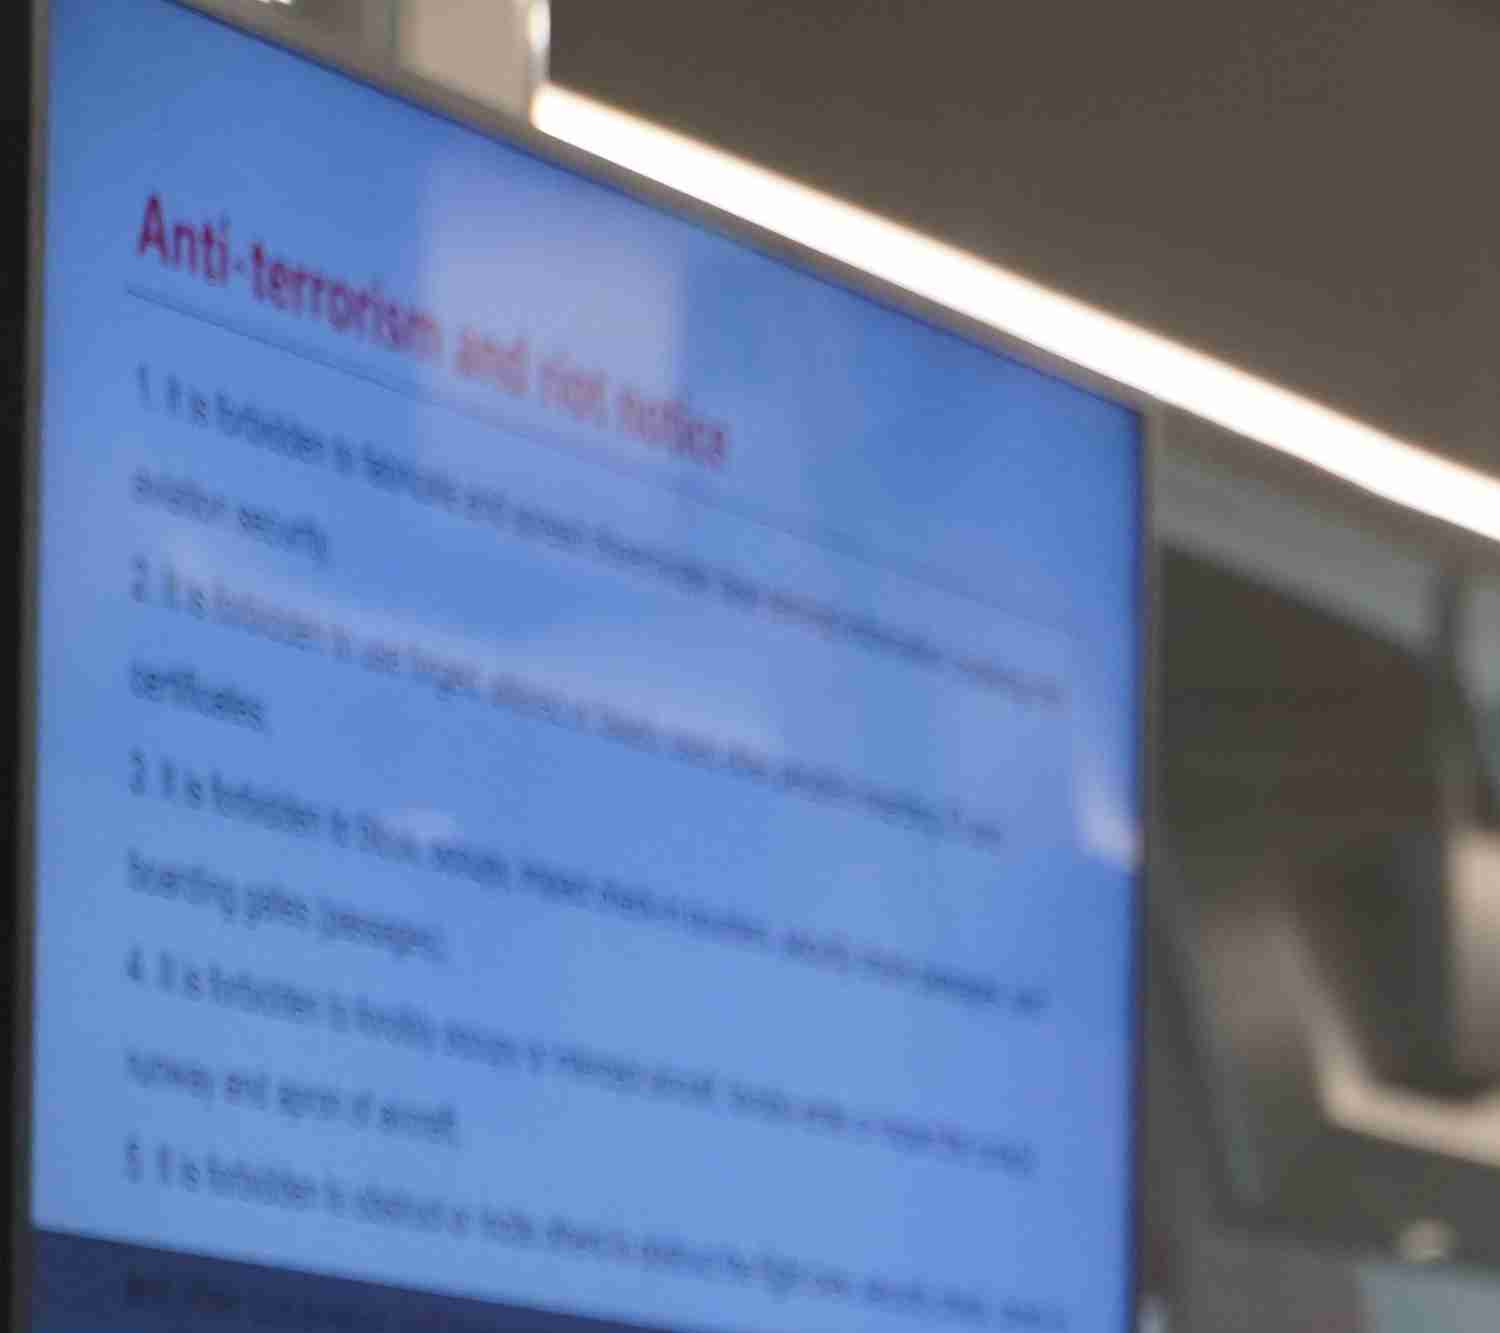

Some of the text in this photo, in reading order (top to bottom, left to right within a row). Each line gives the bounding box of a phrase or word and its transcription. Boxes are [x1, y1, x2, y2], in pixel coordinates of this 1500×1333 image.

[136, 193, 442, 362] Anti-terrorism
[455, 324, 529, 396] and
[613, 390, 731, 468] notice
